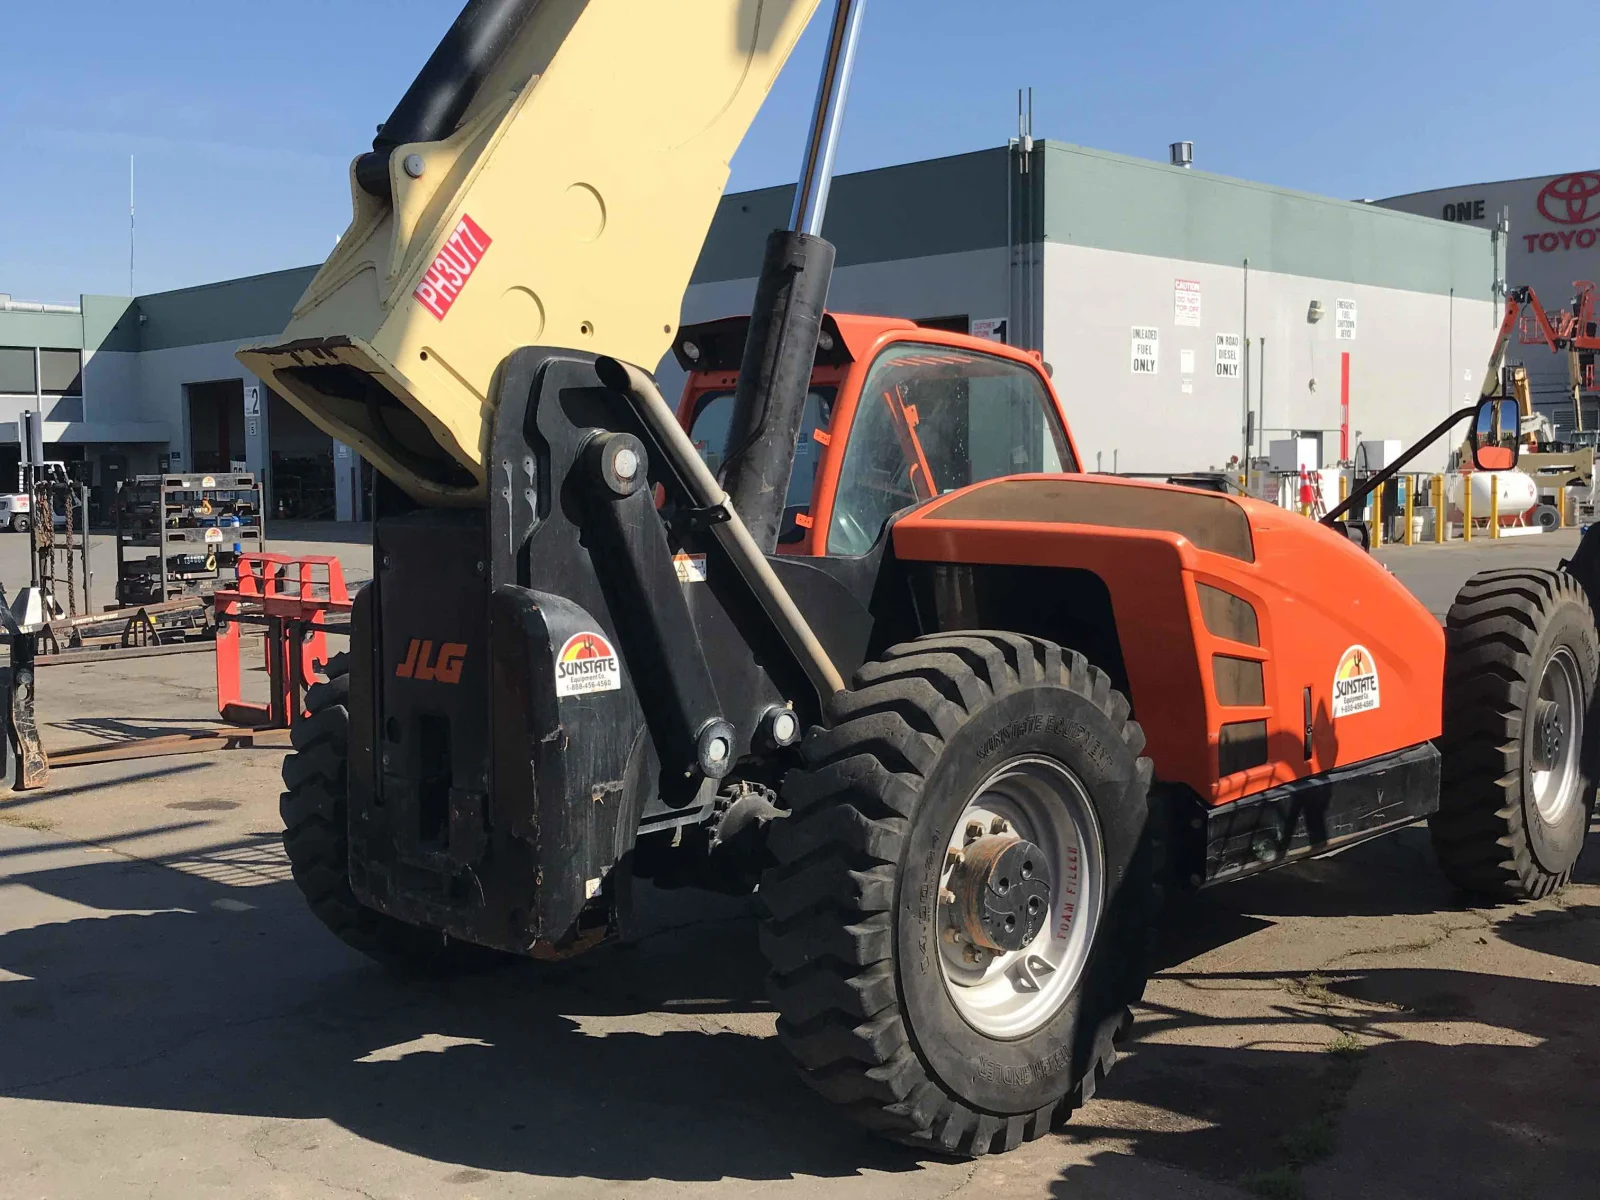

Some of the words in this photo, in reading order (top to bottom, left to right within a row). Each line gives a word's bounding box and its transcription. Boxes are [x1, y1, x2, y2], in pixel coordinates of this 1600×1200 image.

[1443, 200, 1485, 221] ONE
[1523, 228, 1600, 253] TOYO
[416, 220, 486, 315] PH3U77
[1175, 280, 1200, 291] CAUTION
[993, 320, 1007, 344] 1
[1132, 328, 1157, 340] UNLEADED
[1136, 343, 1153, 355] FUEL
[1216, 335, 1224, 346] ON
[1225, 336, 1239, 347] ROAD
[1218, 349, 1237, 361] DIESEL
[1133, 358, 1155, 372] ONLY
[1216, 362, 1238, 376] ONLY
[251, 388, 260, 415] 2
[396, 638, 468, 684] JLG
[558, 658, 617, 679] SUNSTATE
[570, 675, 598, 683] Equipment
[1335, 675, 1377, 699] SUNSTATE
[1343, 694, 1364, 704] Equipment
[1056, 902, 1075, 940] FOAM
